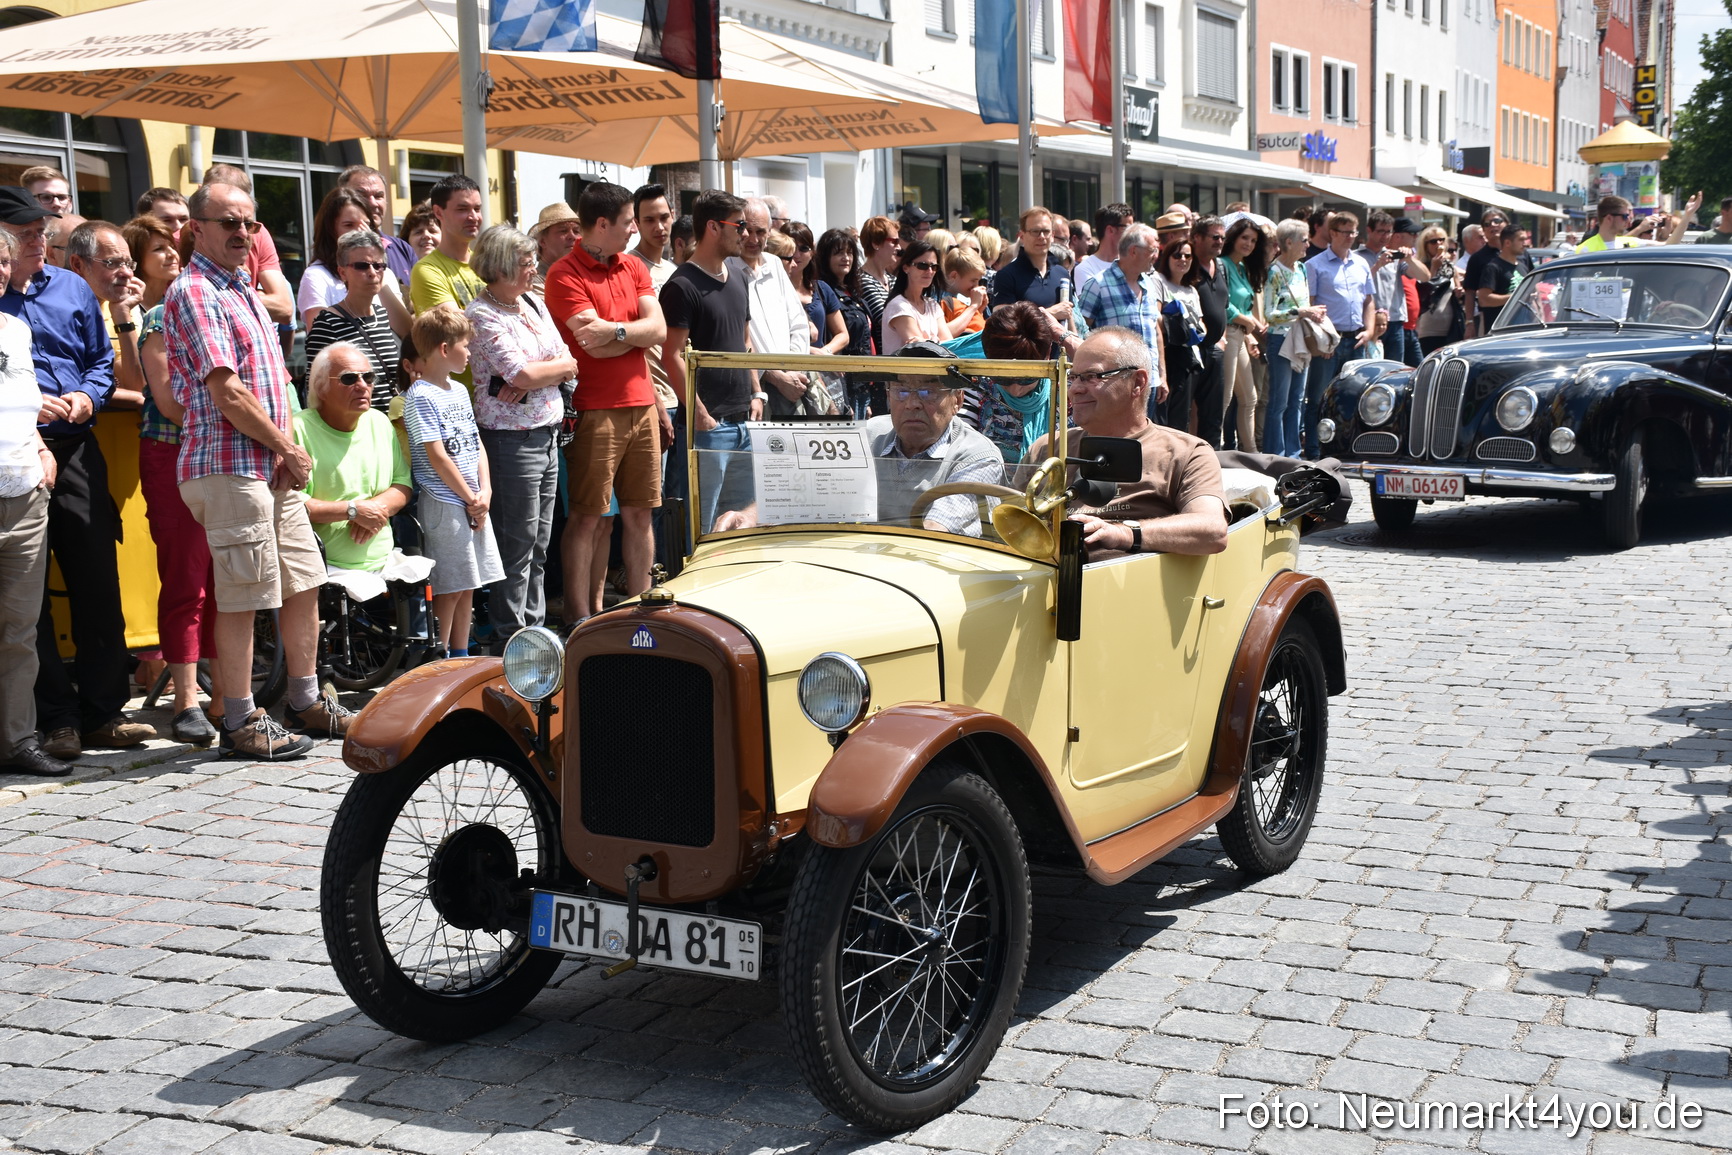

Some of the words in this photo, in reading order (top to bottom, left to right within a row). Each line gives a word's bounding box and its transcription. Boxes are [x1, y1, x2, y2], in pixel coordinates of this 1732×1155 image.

[71, 26, 268, 46] Neumarkter
[0, 37, 271, 63] Lammsbräu
[1595, 285, 1613, 295] 346
[808, 440, 852, 461] 293
[1386, 477, 1404, 493] NM
[1412, 477, 1458, 494] 06149
[1096, 502, 1130, 515] gelaufen
[632, 630, 653, 648] DIXI
[537, 925, 546, 937] D
[553, 902, 601, 949] RH
[685, 922, 731, 970] 81
[738, 930, 754, 943] 05
[740, 960, 754, 973] 10
